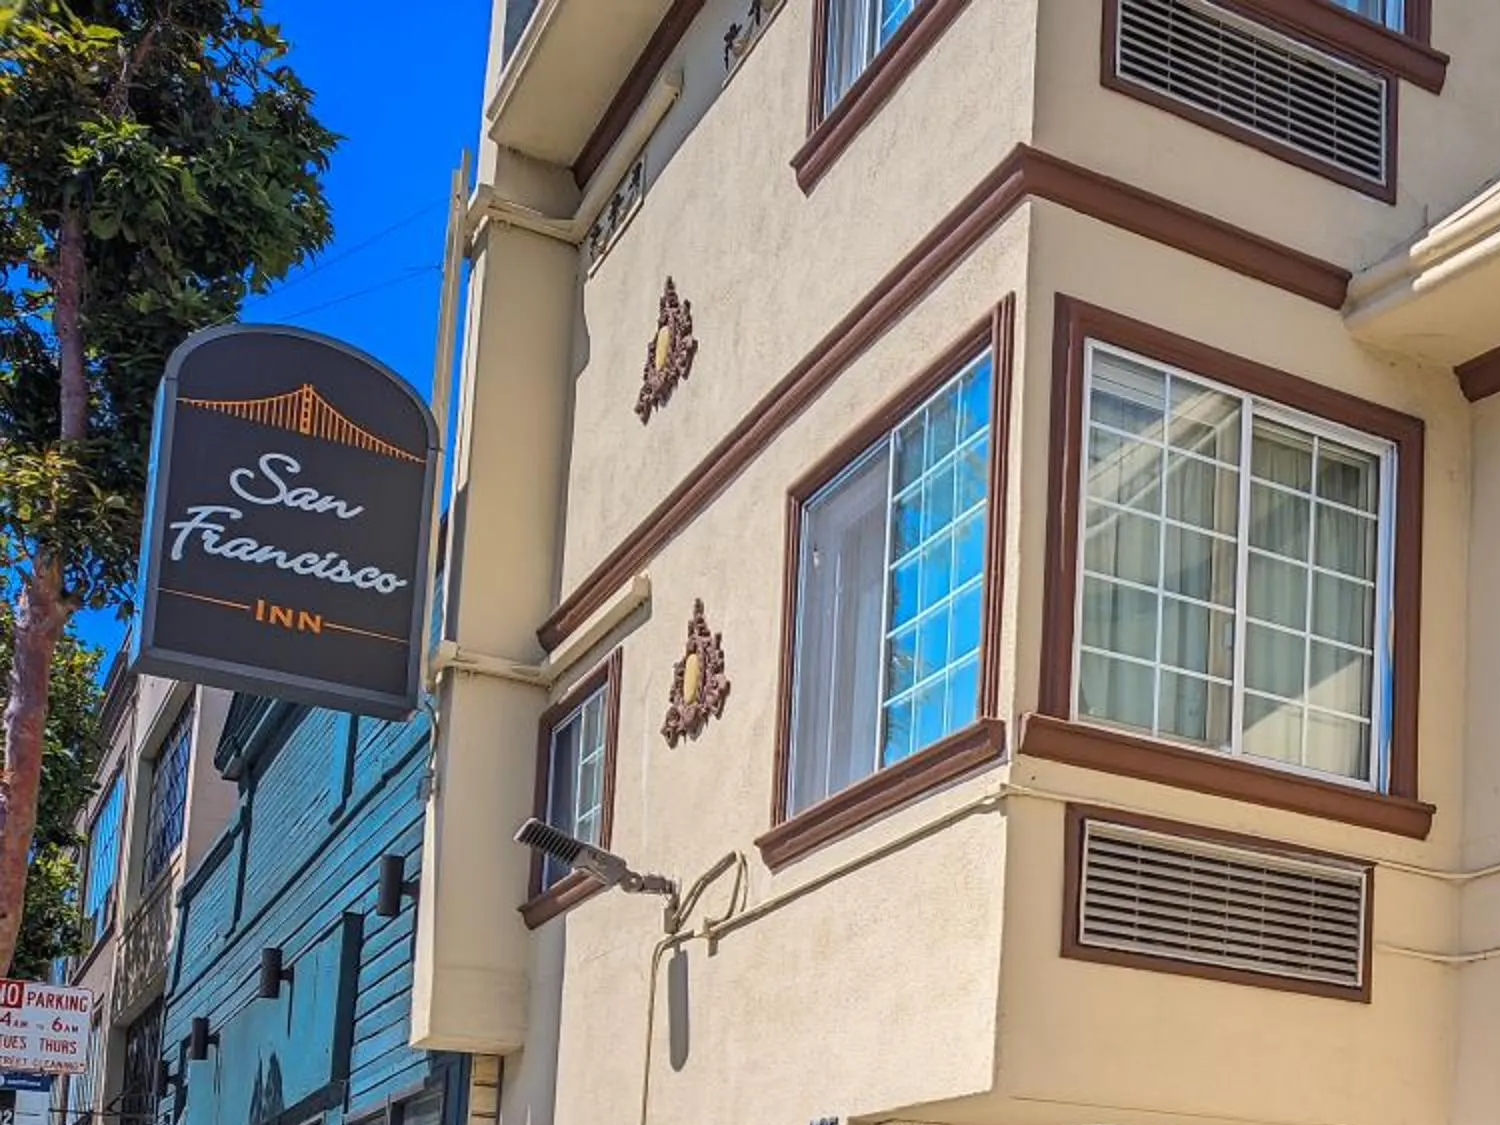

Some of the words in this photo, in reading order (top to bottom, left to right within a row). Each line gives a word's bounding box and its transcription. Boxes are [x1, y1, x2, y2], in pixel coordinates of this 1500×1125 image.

[229, 453, 364, 519] San
[170, 506, 408, 593] Francisco
[254, 600, 324, 634] INN
[27, 991, 89, 1013] PARKING
[40, 1037, 77, 1055] THURS
[0, 1109, 12, 1125] 2
